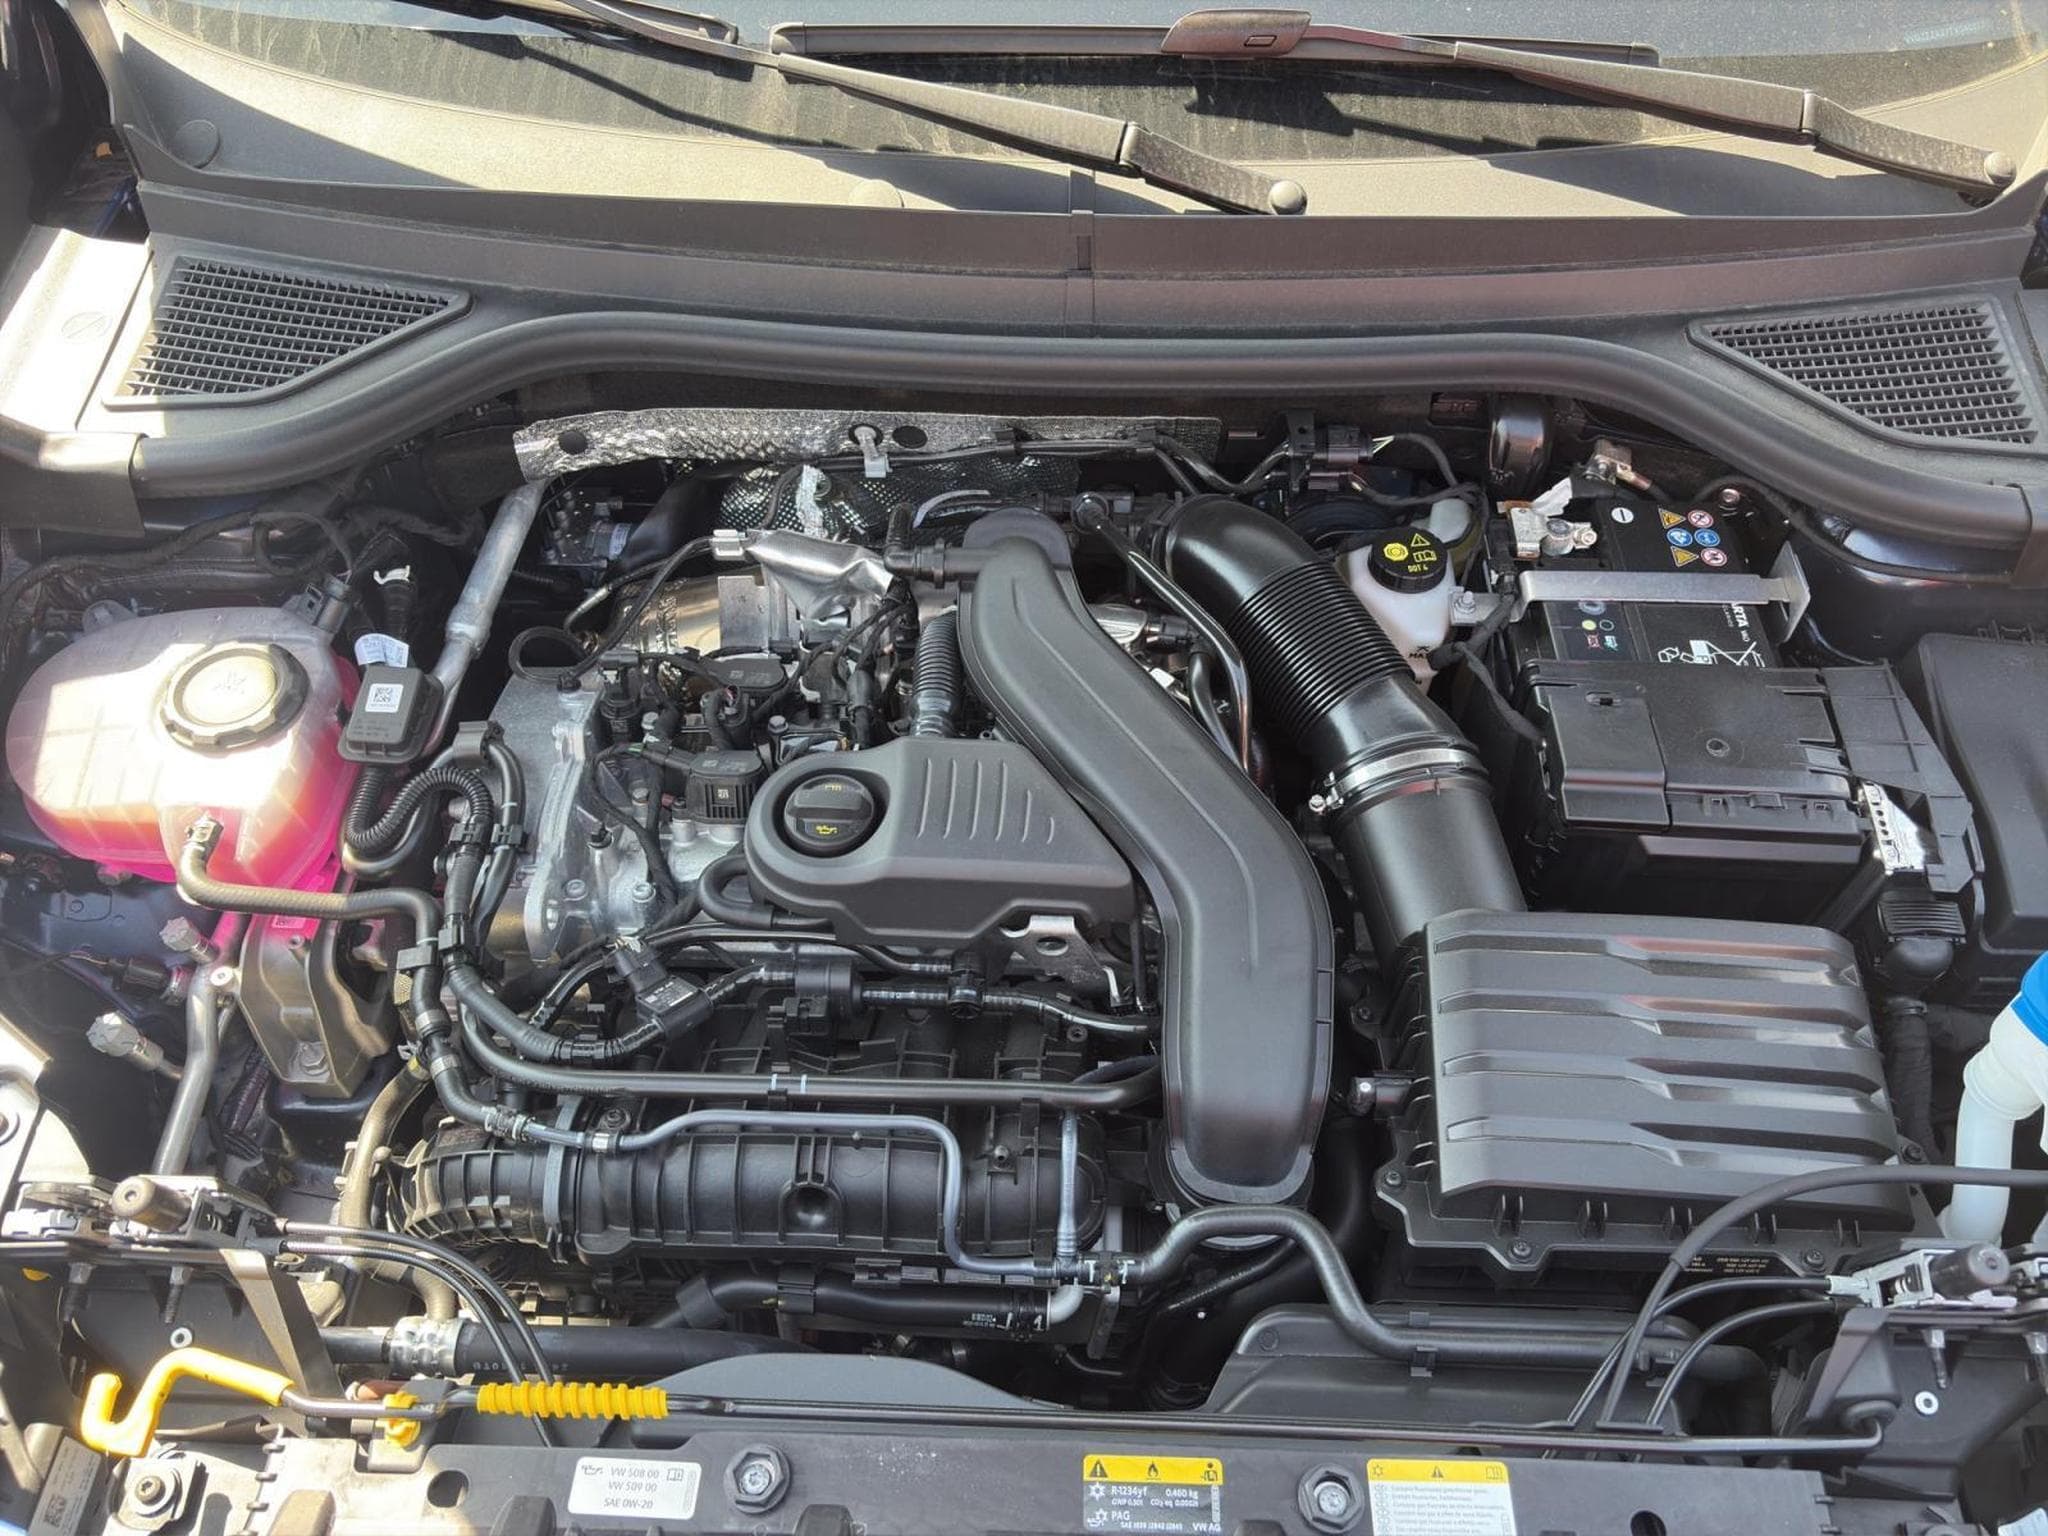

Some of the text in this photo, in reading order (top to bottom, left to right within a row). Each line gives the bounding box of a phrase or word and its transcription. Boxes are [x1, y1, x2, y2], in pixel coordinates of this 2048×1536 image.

[610, 1466, 660, 1479] VW 508 00
[608, 1480, 657, 1493] VW 509 00
[1111, 1485, 1148, 1498] R-1234yf
[1189, 1488, 1199, 1500] kg
[604, 1497, 654, 1509] SAE 0W-20
[1111, 1511, 1131, 1521] PAG
[1192, 1522, 1207, 1531] VW
[1208, 1522, 1222, 1532] AG
